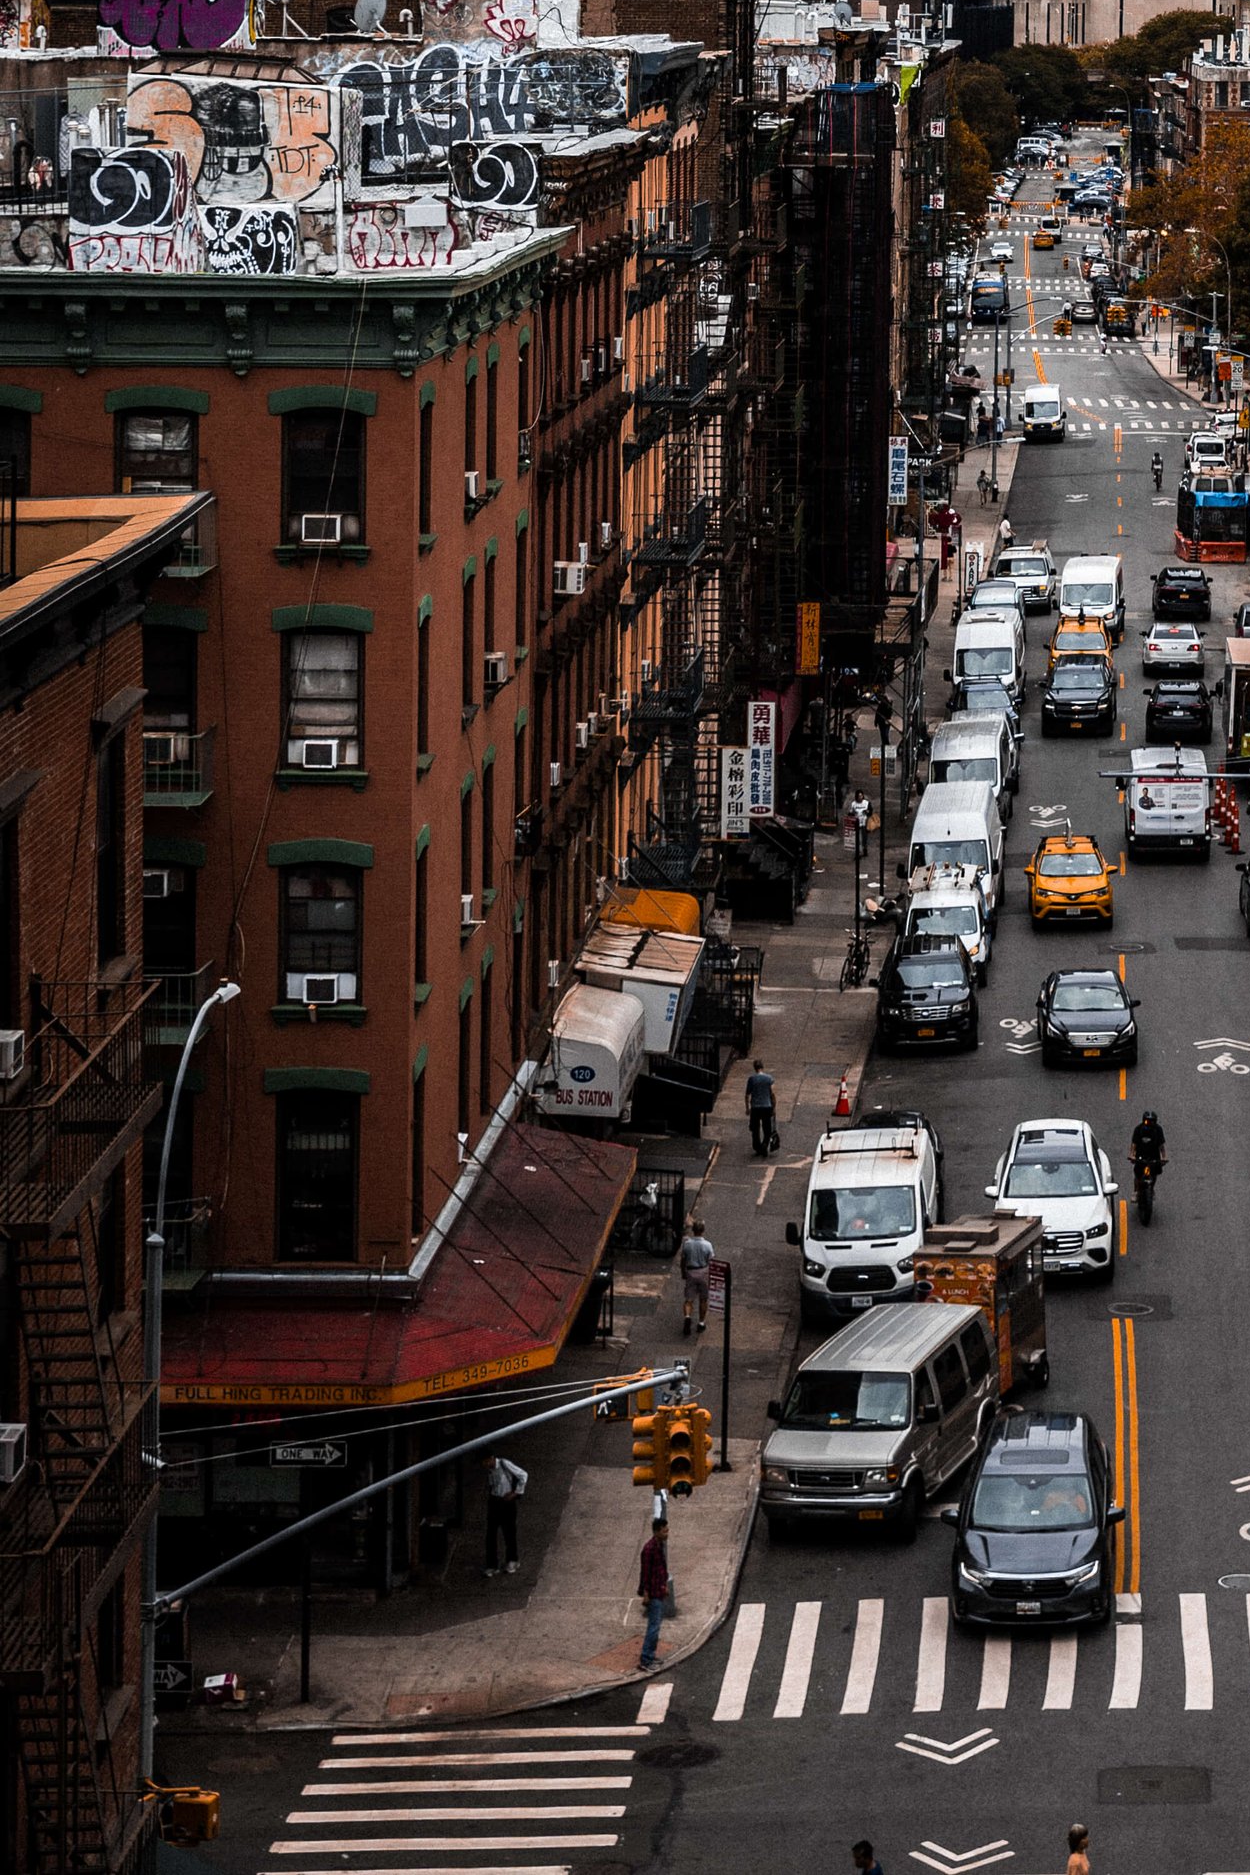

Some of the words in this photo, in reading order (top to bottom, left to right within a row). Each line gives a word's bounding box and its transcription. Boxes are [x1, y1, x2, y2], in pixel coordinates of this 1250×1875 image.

[907, 457, 933, 467] PARK
[752, 704, 771, 745] 勇華
[727, 750, 744, 815] 金榕彩印
[574, 1069, 591, 1080] 120
[556, 1089, 574, 1105] BUS
[578, 1090, 613, 1106] STATION
[422, 1373, 456, 1393] TEL:
[462, 1355, 530, 1384] 349-7036
[175, 1387, 216, 1401] FULL
[222, 1387, 262, 1401] HING
[267, 1387, 345, 1402] TRADING
[350, 1387, 383, 1402] INC.
[281, 1448, 304, 1460] ONE
[313, 1447, 337, 1460] WAY
